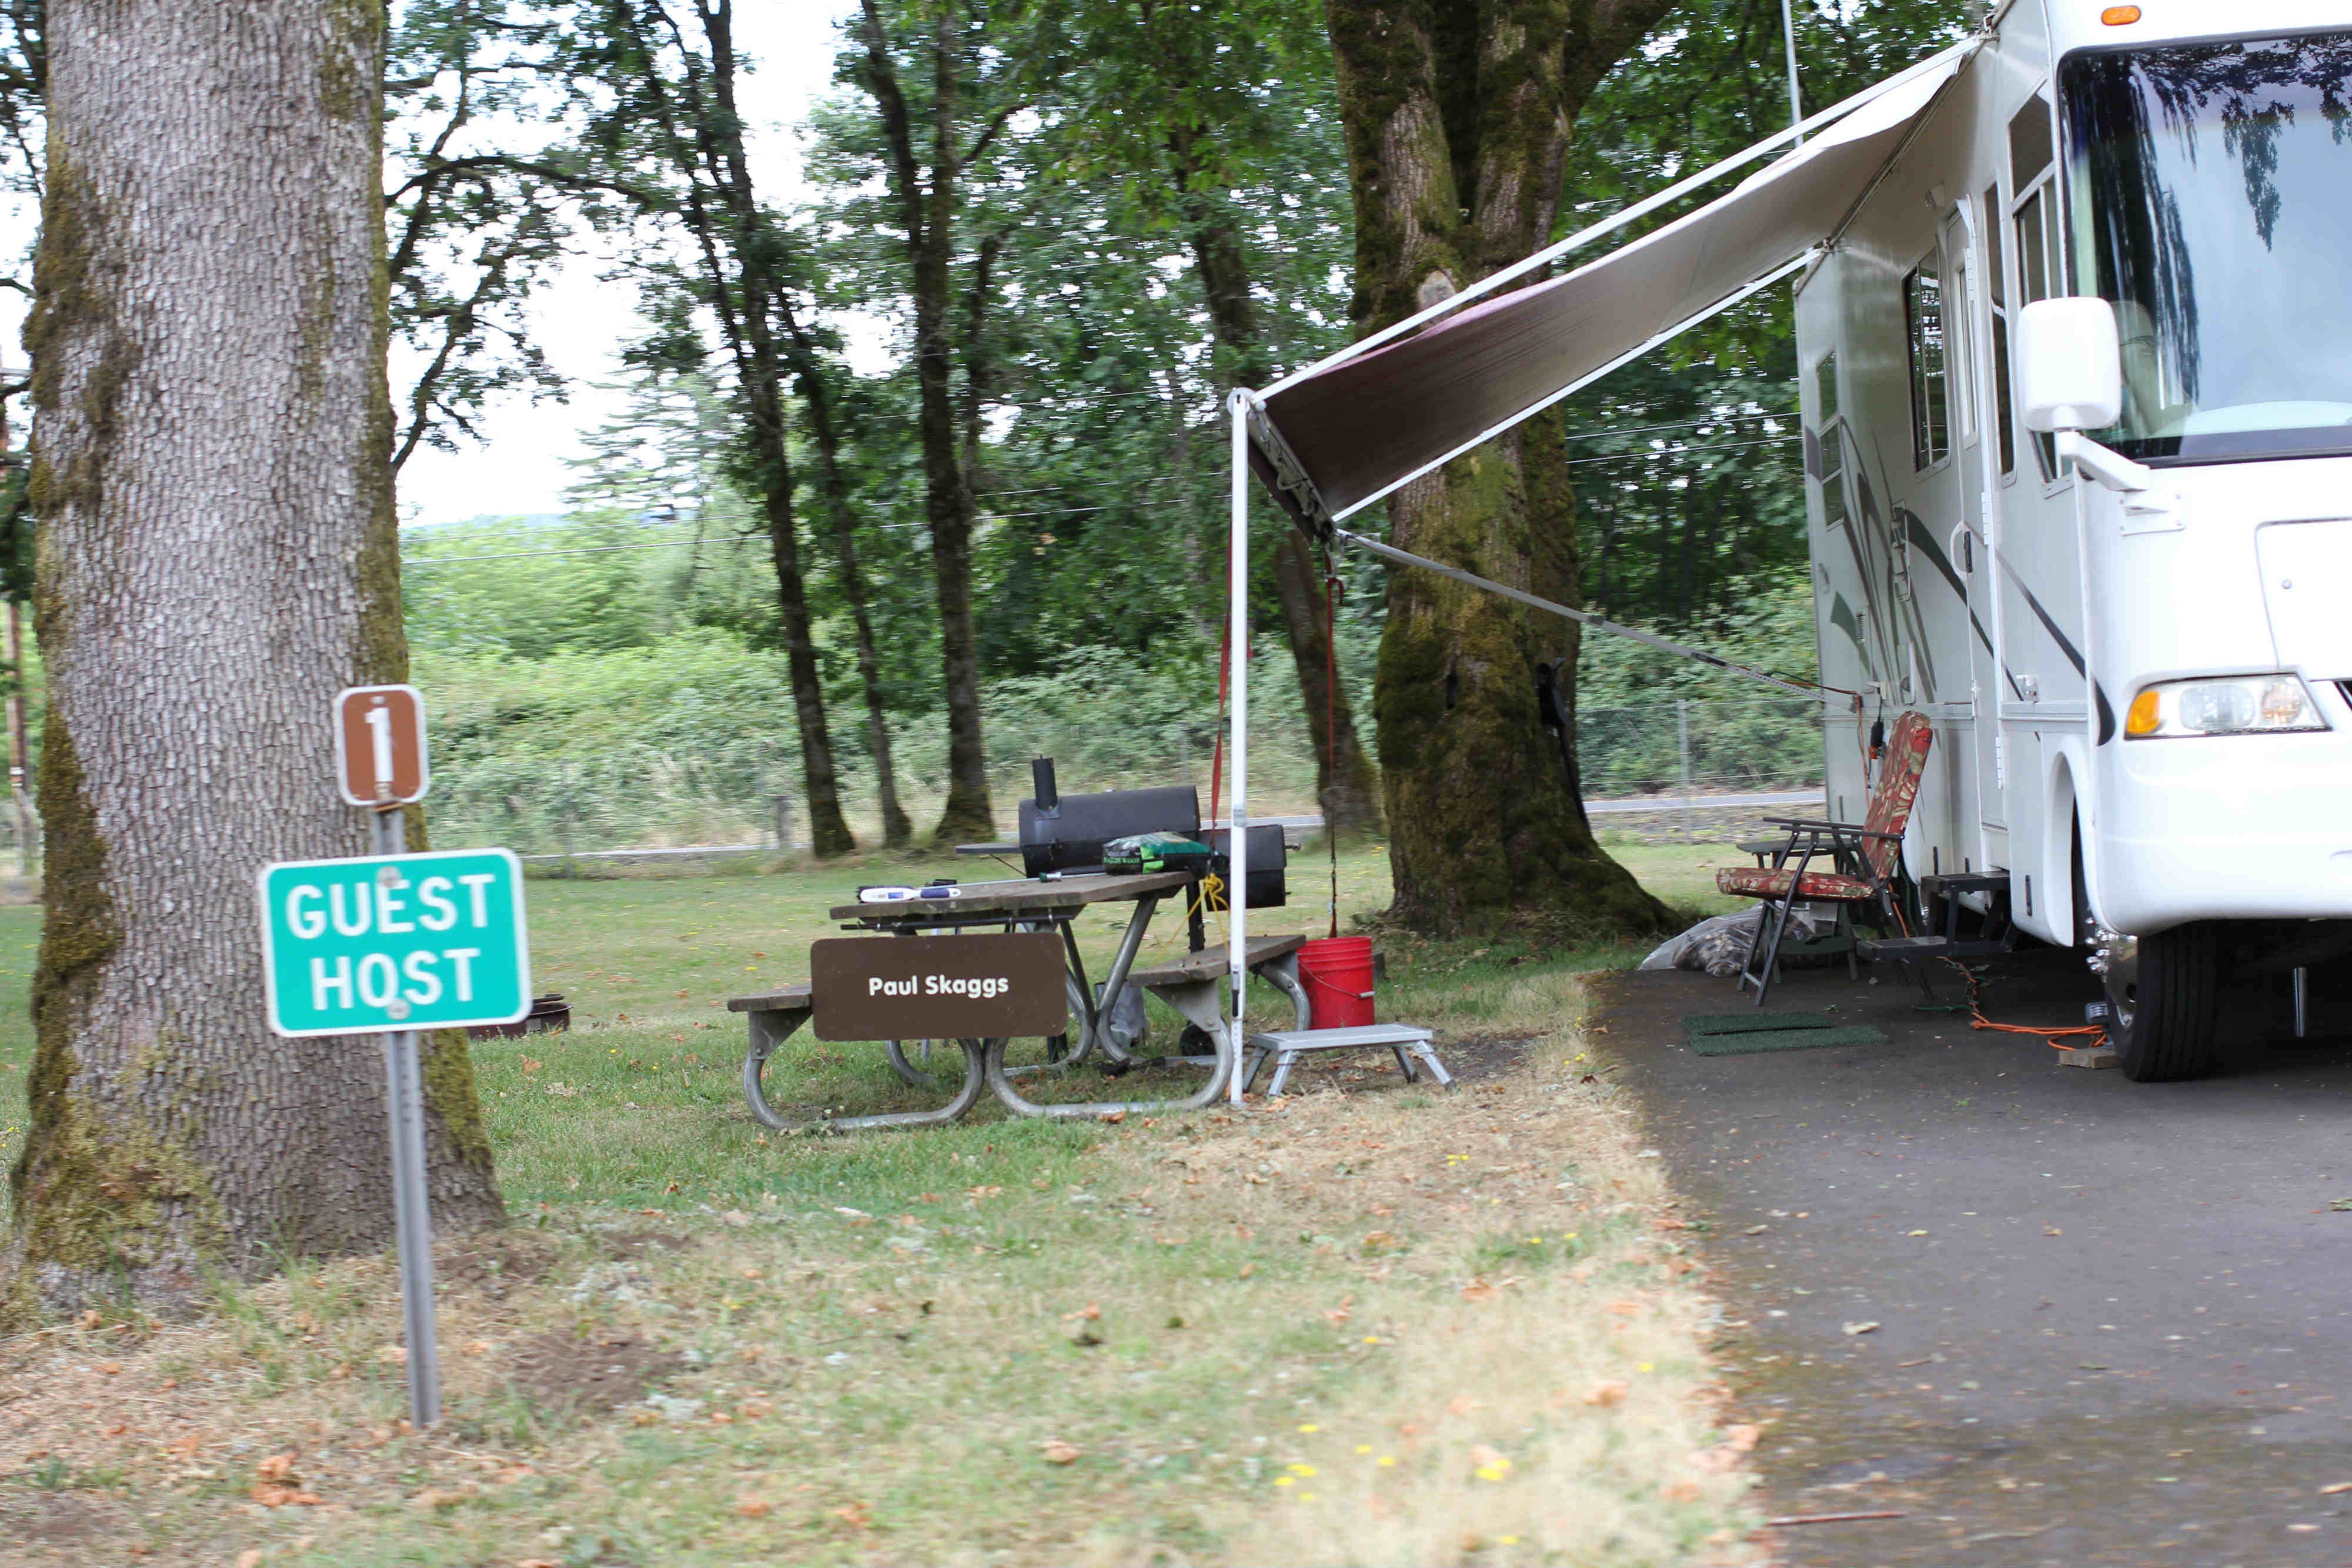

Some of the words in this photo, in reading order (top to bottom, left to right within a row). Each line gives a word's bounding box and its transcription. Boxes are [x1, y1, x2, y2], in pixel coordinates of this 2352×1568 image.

[364, 707, 394, 783] 1
[285, 873, 496, 940] GUEST
[310, 948, 481, 1011] HOST
[868, 975, 918, 996] Paul
[925, 974, 1009, 999] Skaggs
